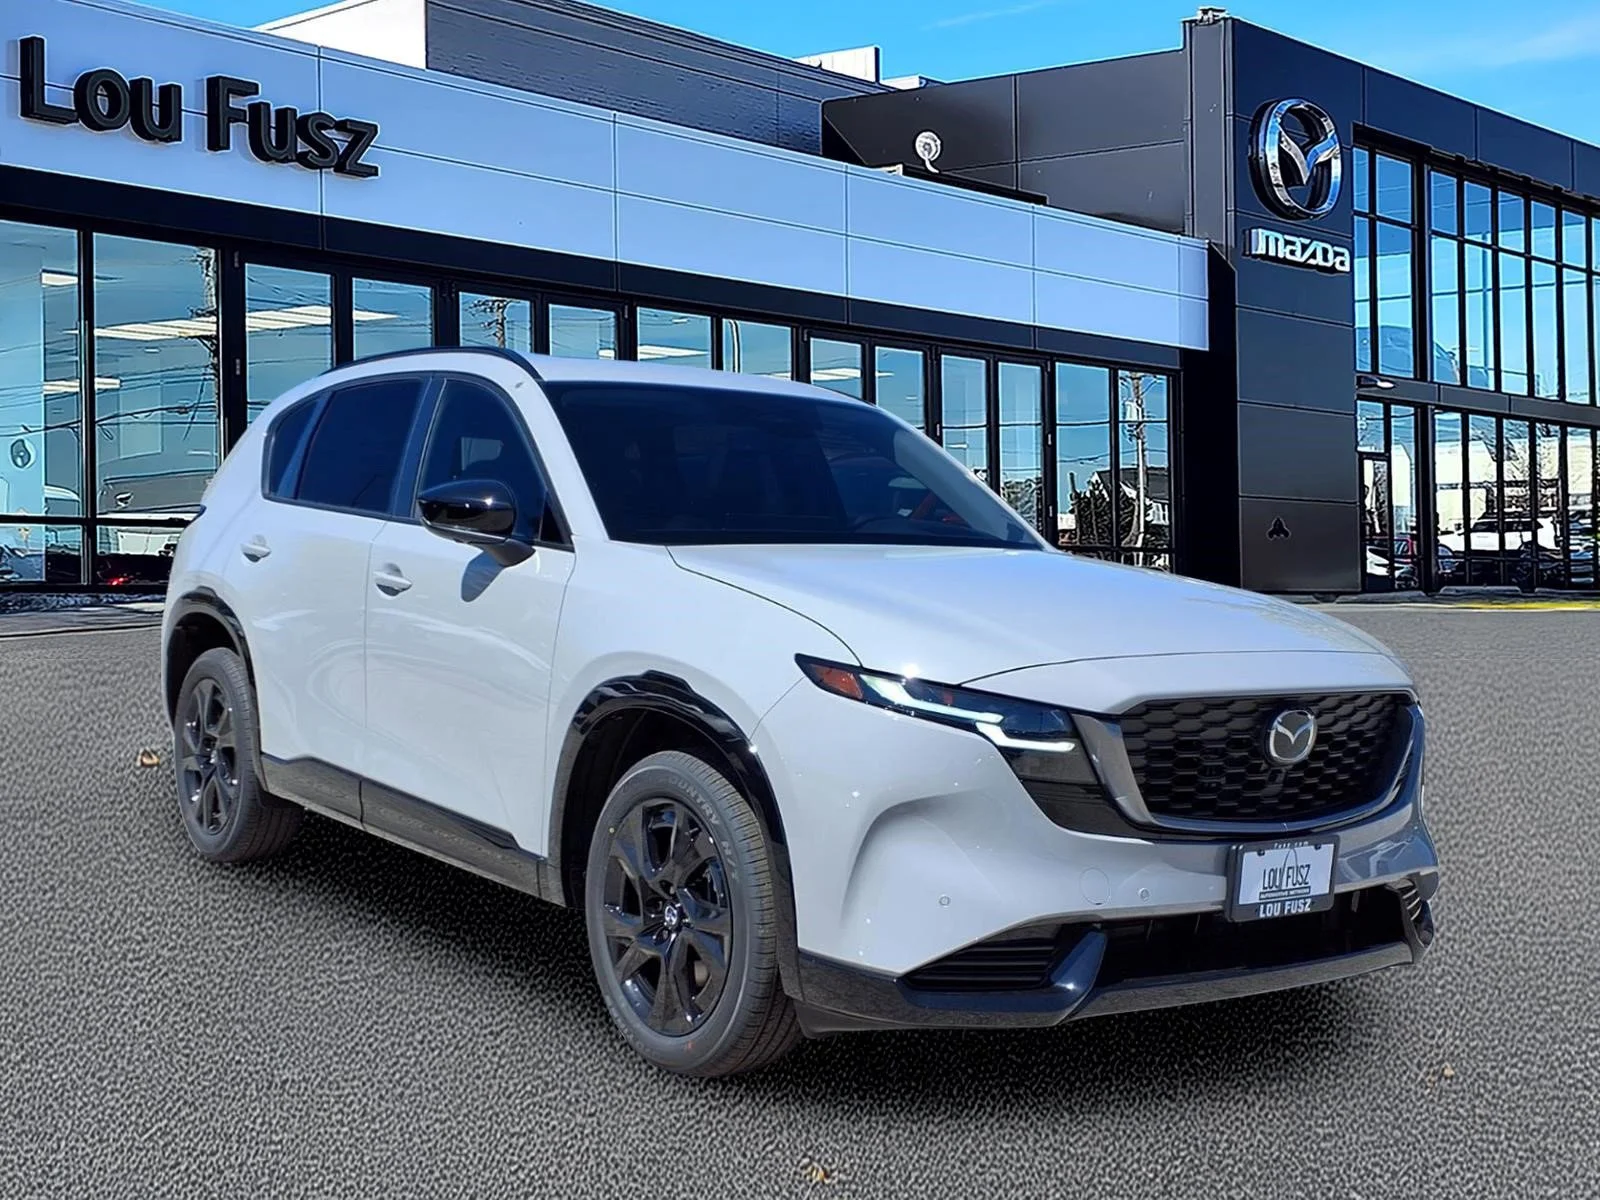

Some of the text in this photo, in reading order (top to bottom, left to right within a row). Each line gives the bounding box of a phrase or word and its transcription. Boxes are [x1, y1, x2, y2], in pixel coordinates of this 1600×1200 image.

[19, 36, 379, 177] Lou Fusz
[1262, 863, 1311, 890] LOU FUSZ
[1259, 898, 1312, 918] LOU FUSZ
